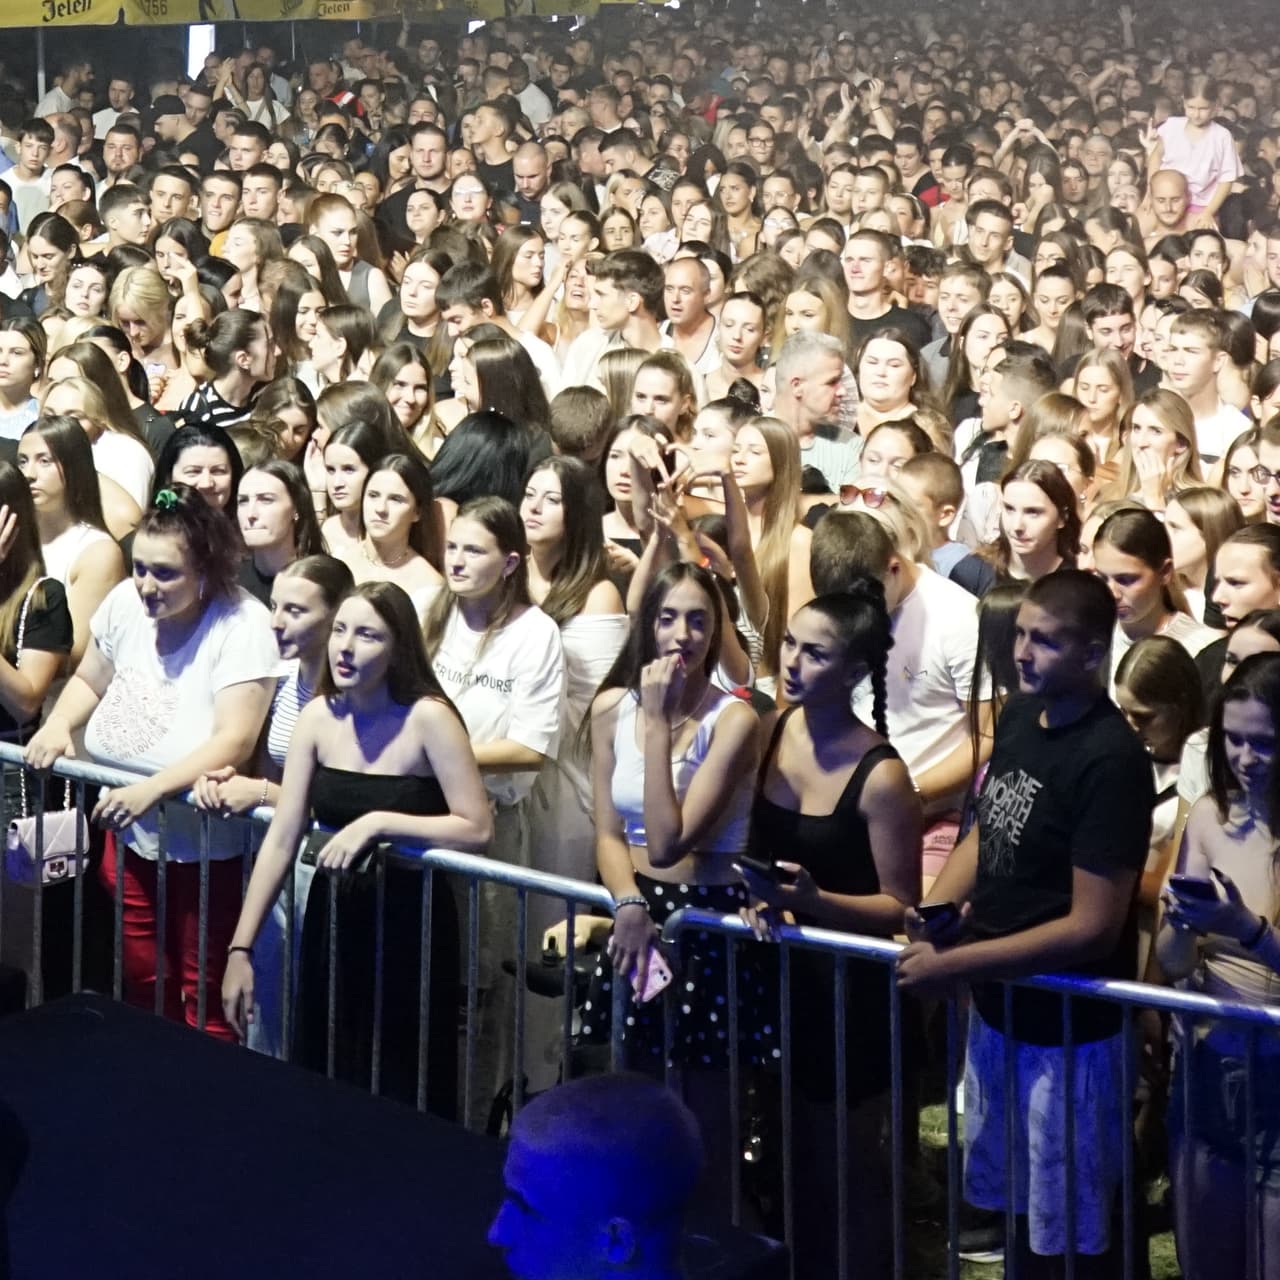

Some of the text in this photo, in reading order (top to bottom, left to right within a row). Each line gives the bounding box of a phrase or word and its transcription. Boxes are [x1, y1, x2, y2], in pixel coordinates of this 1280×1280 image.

[985, 775, 1033, 824] NORTH
[1014, 768, 1044, 802] THE
[986, 804, 1024, 846] FACE
